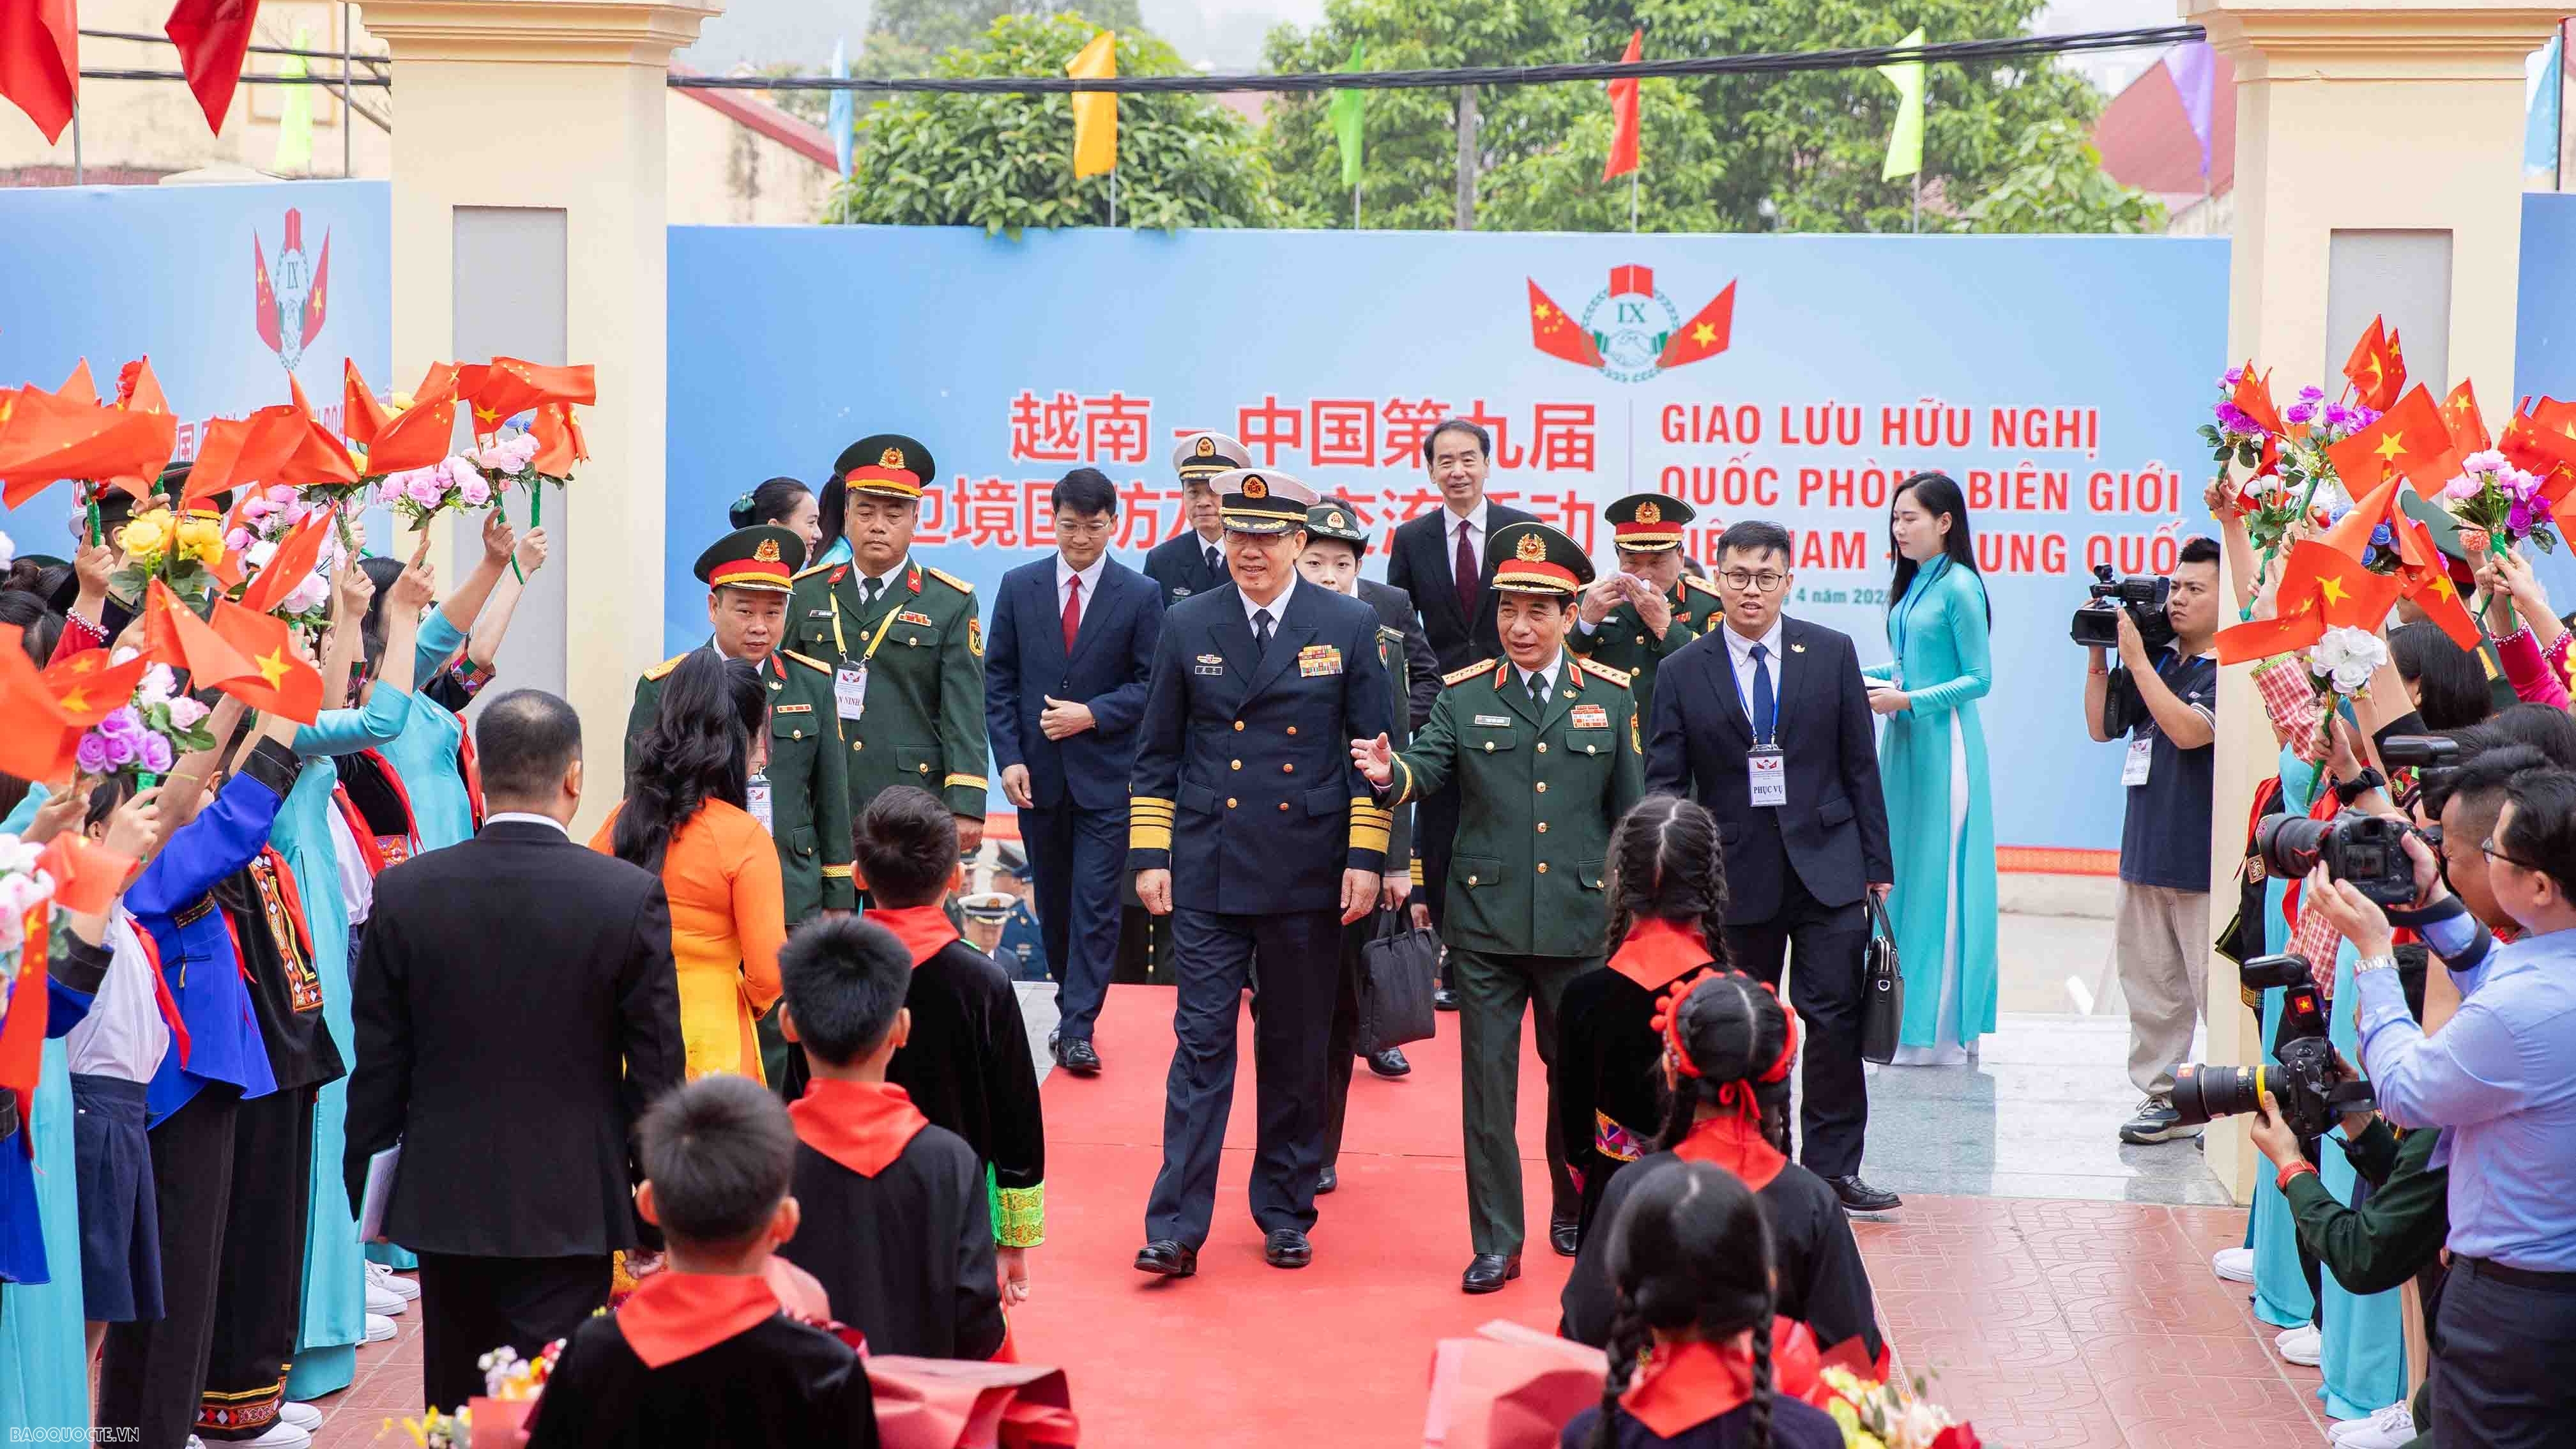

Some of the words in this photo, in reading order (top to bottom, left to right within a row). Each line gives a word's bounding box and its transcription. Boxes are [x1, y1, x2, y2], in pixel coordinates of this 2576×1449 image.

[1618, 302, 1646, 323] IX
[1661, 403, 1762, 445] GIAO
[1780, 399, 1862, 446] LƯU
[1881, 397, 1971, 447] HỮU
[1992, 408, 2098, 459] NGHỊ
[1661, 452, 1779, 507] QUỐC
[1968, 460, 2068, 510] BIÊN
[2088, 462, 2179, 514] GIỚI
[1978, 533, 2066, 574] UNG
[2086, 519, 2204, 575] QUỐ
[1795, 588, 1806, 602] 4
[1812, 586, 1847, 603] năm
